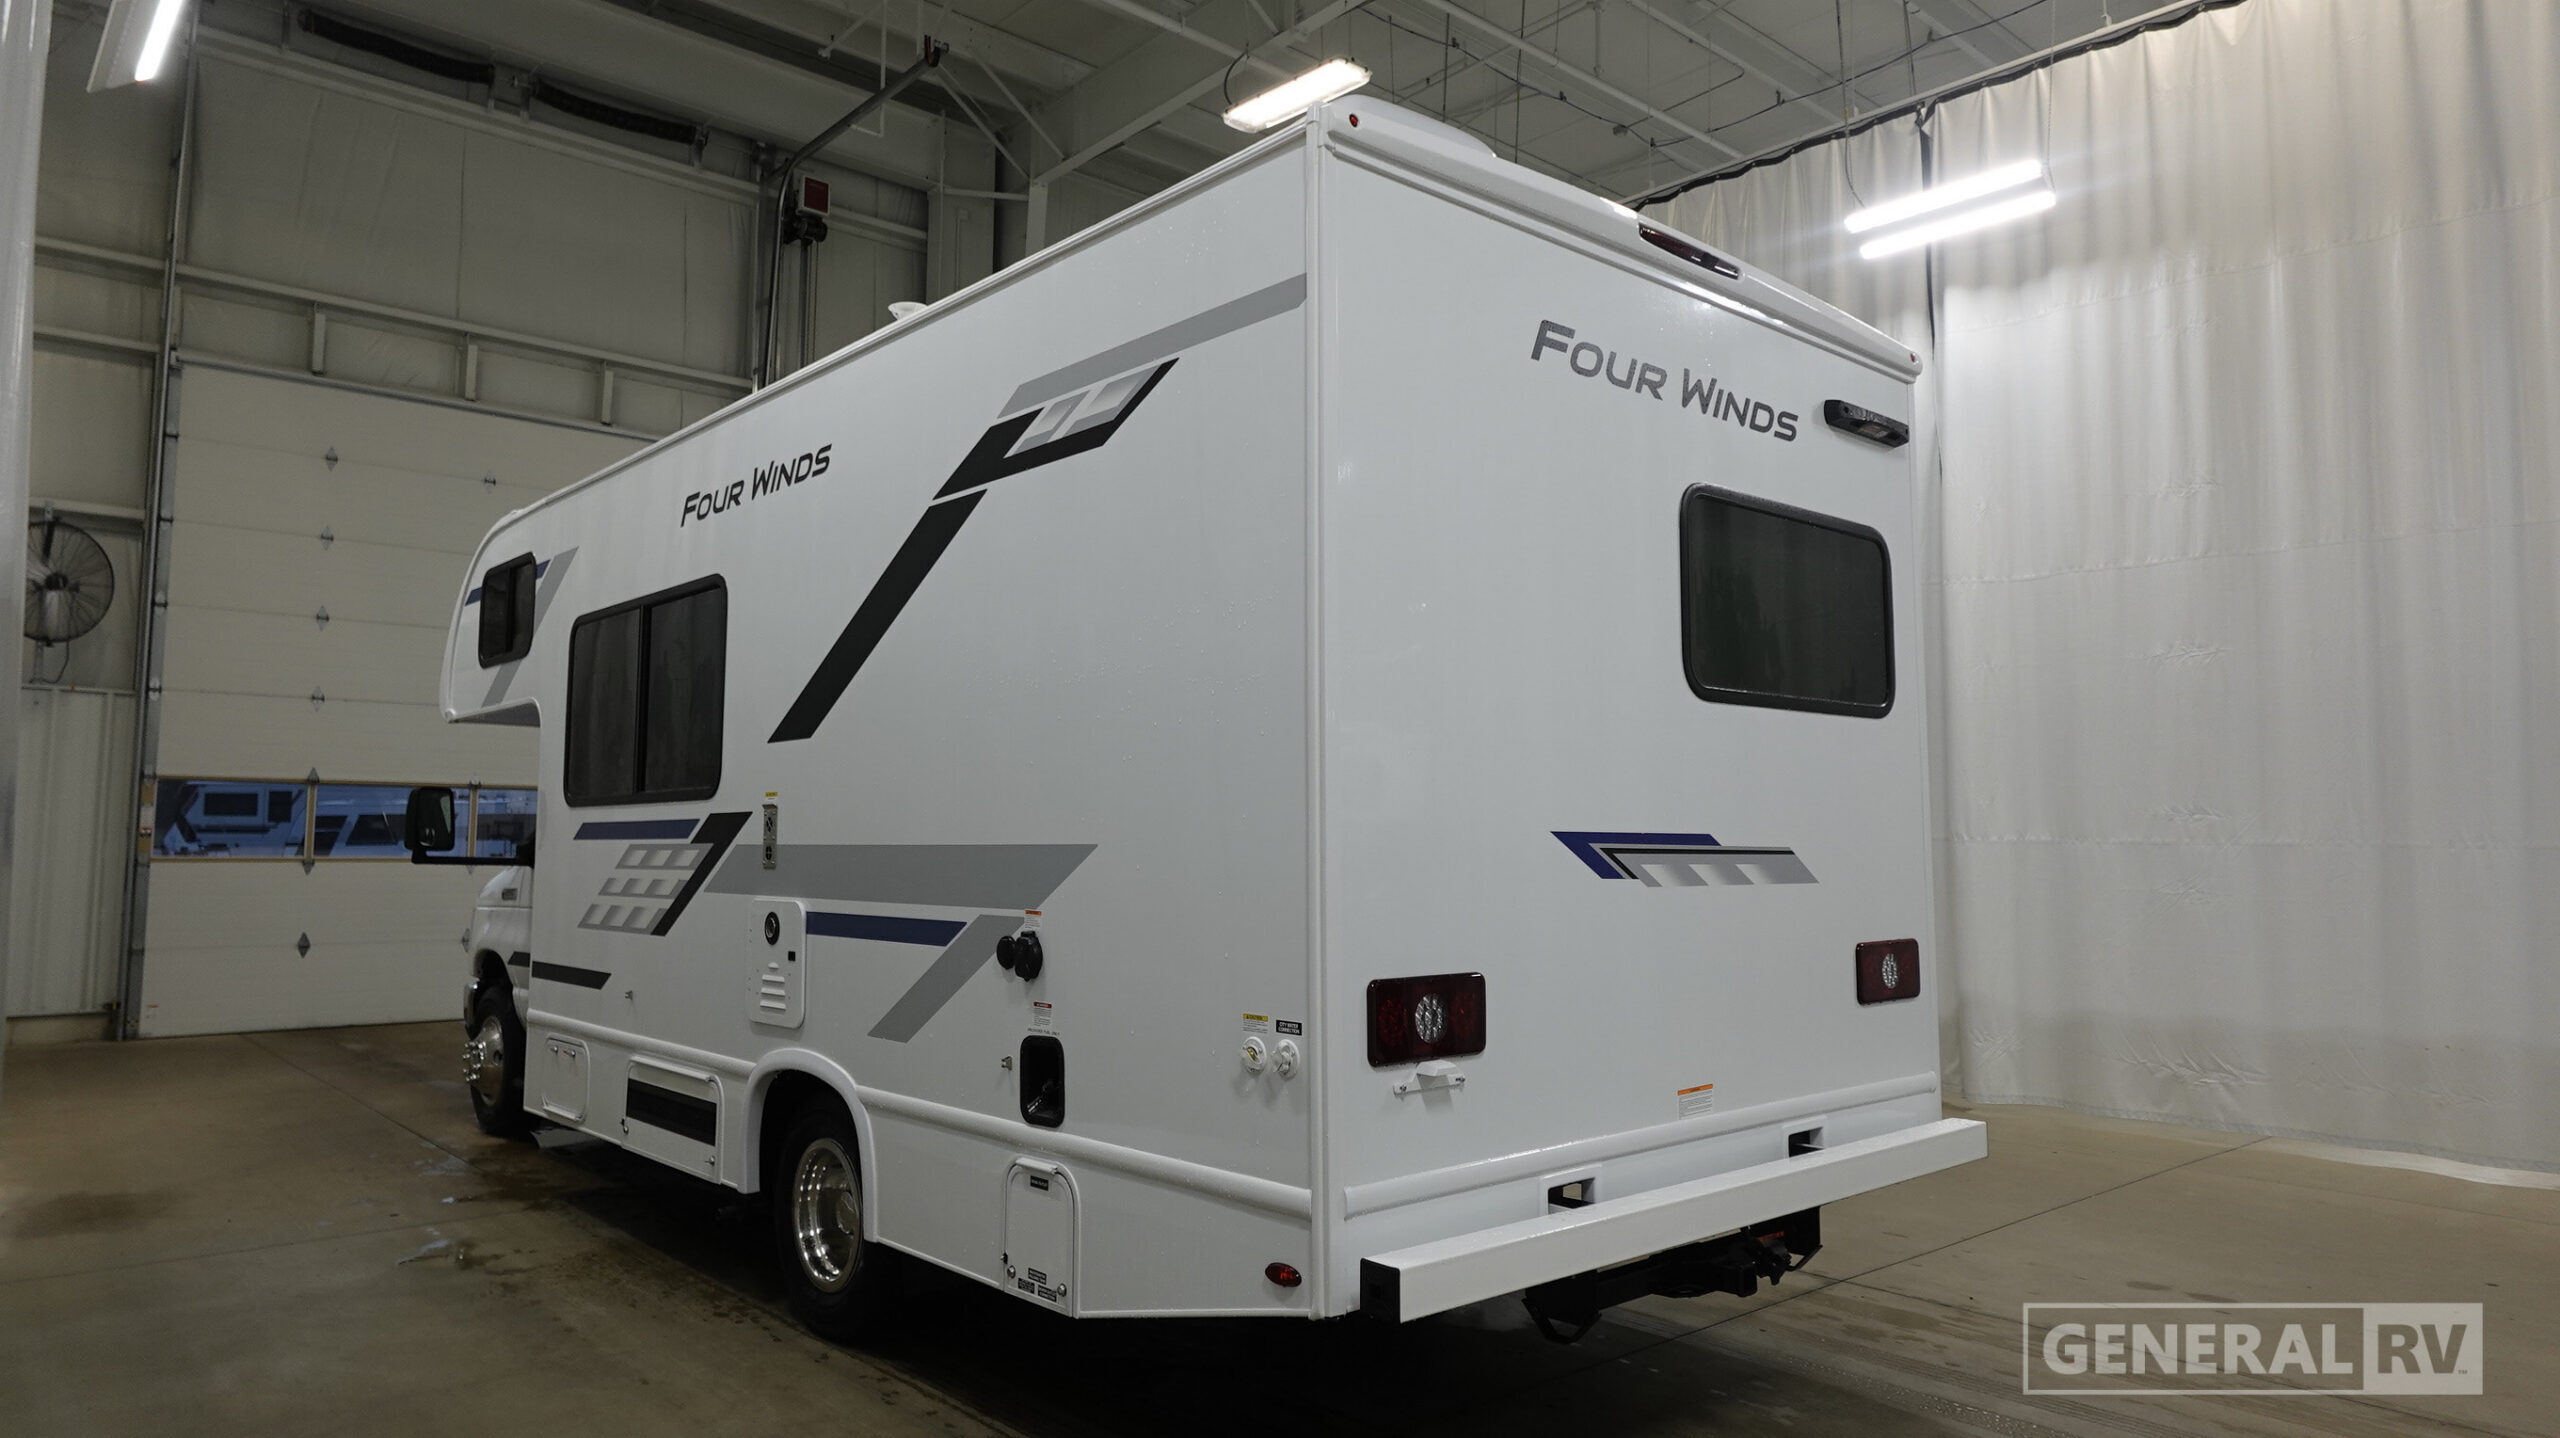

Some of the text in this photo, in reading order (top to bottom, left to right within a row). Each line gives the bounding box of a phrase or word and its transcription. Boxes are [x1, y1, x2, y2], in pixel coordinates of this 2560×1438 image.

[1531, 320, 1799, 442] FOUR WINDS
[680, 443, 833, 528] FOUR WINDS
